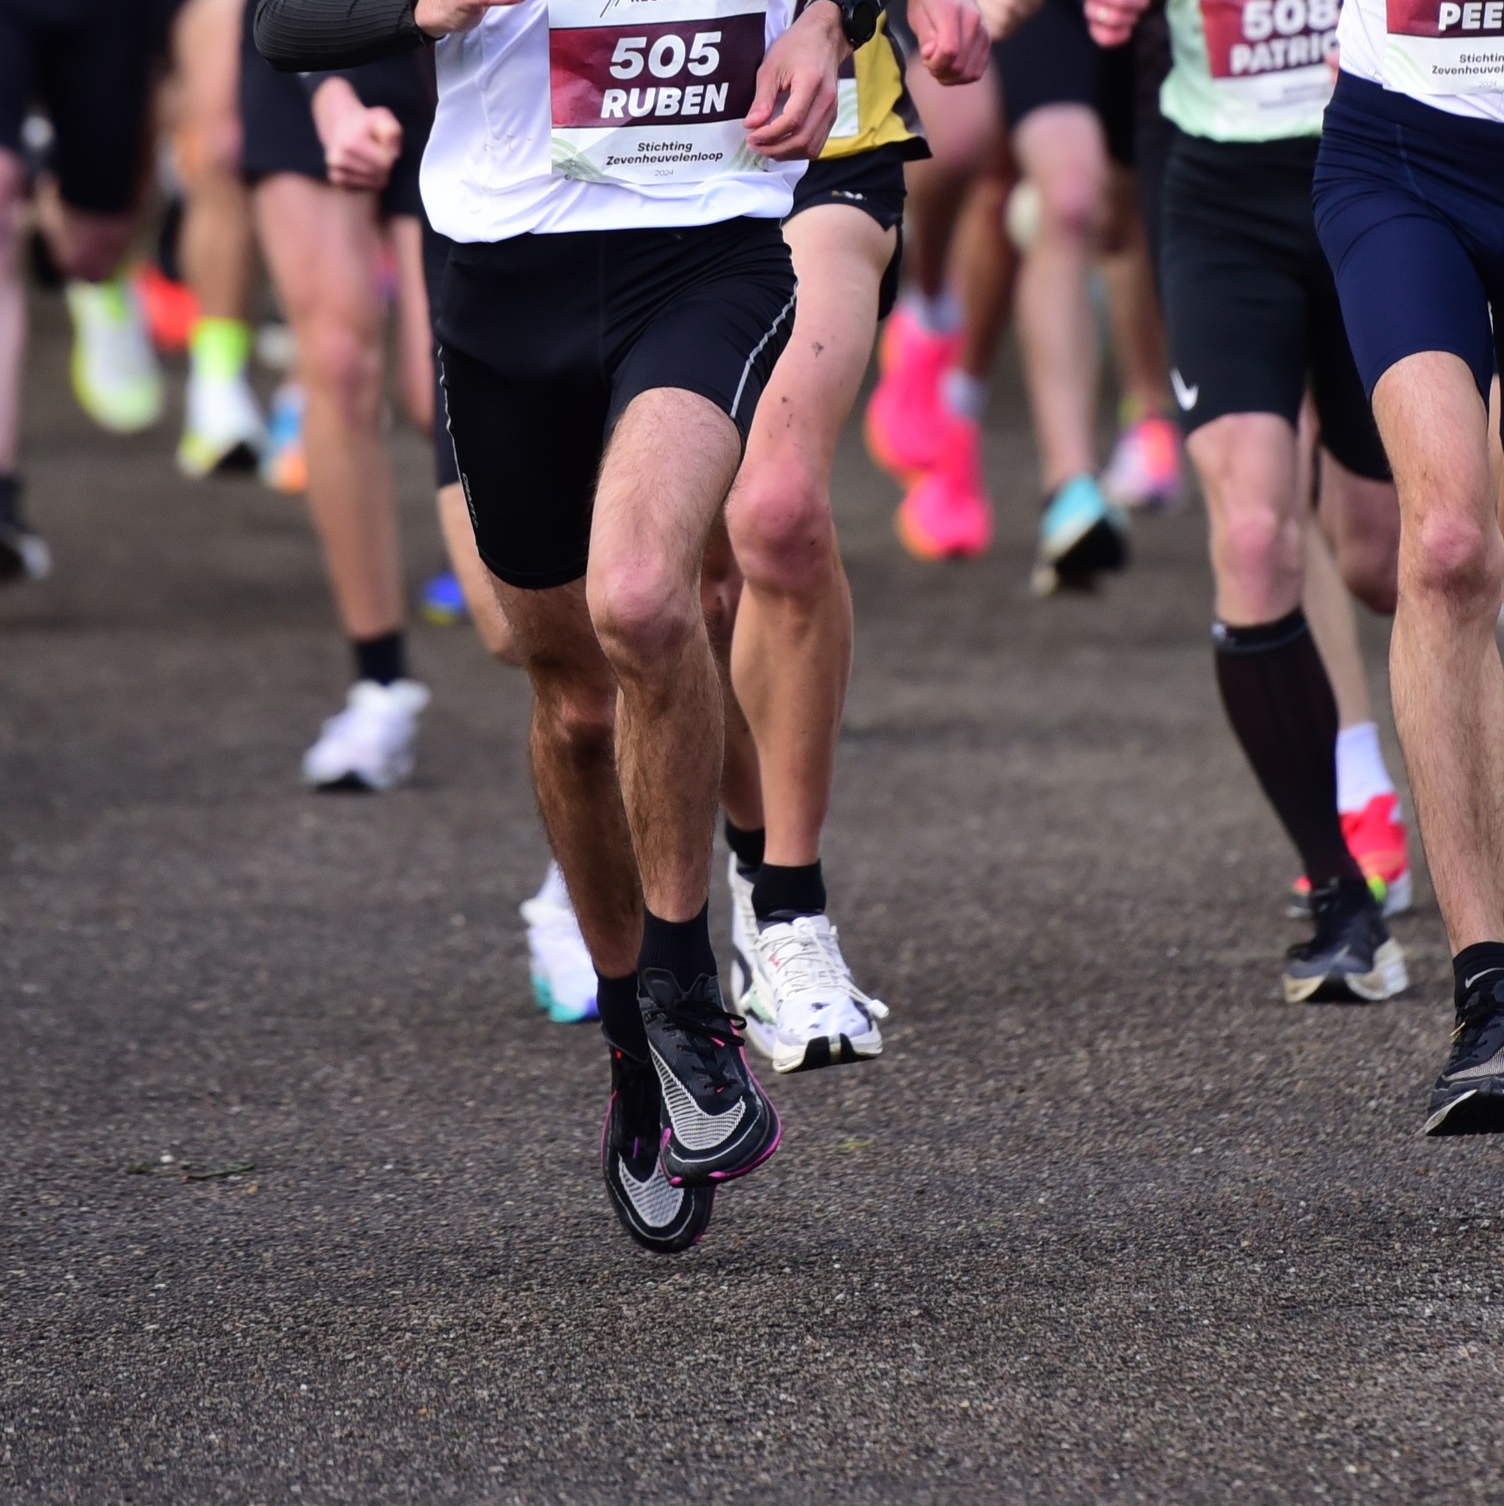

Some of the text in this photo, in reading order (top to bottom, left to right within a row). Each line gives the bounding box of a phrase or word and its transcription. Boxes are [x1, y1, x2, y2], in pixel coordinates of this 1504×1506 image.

[608, 30, 723, 81] 505
[599, 81, 730, 119] RUBEN
[636, 140, 694, 153] Stichting
[605, 151, 724, 167] Zevenheuvelenloop
[653, 169, 675, 178] 2024
